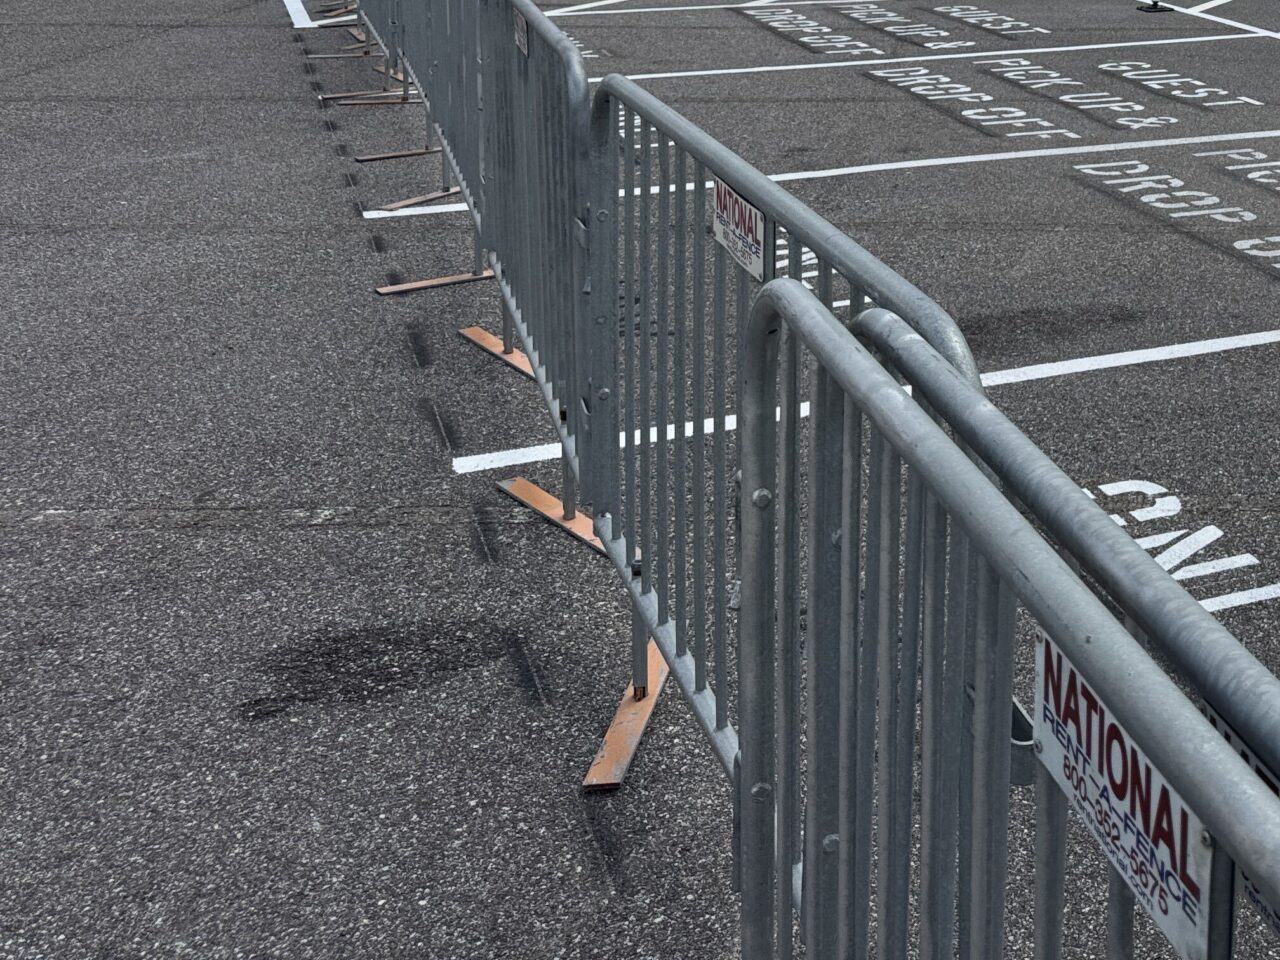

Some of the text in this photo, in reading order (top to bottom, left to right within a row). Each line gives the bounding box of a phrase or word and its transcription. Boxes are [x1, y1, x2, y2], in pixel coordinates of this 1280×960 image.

[742, 7, 885, 55] DROP OFF
[831, 3, 976, 50] PICK UP &
[933, 5, 1051, 35] GUEST
[868, 66, 1082, 139] DROP OFF
[973, 57, 1179, 130] PICK UP &
[1097, 61, 1265, 108] GUEST
[716, 179, 762, 248] NATIONAL
[1072, 159, 1258, 224] DROP
[1043, 638, 1201, 904] NATIONAL
[1043, 703, 1199, 928] RENT-A-FENCE
[1063, 754, 1168, 916] 800-352-5675
